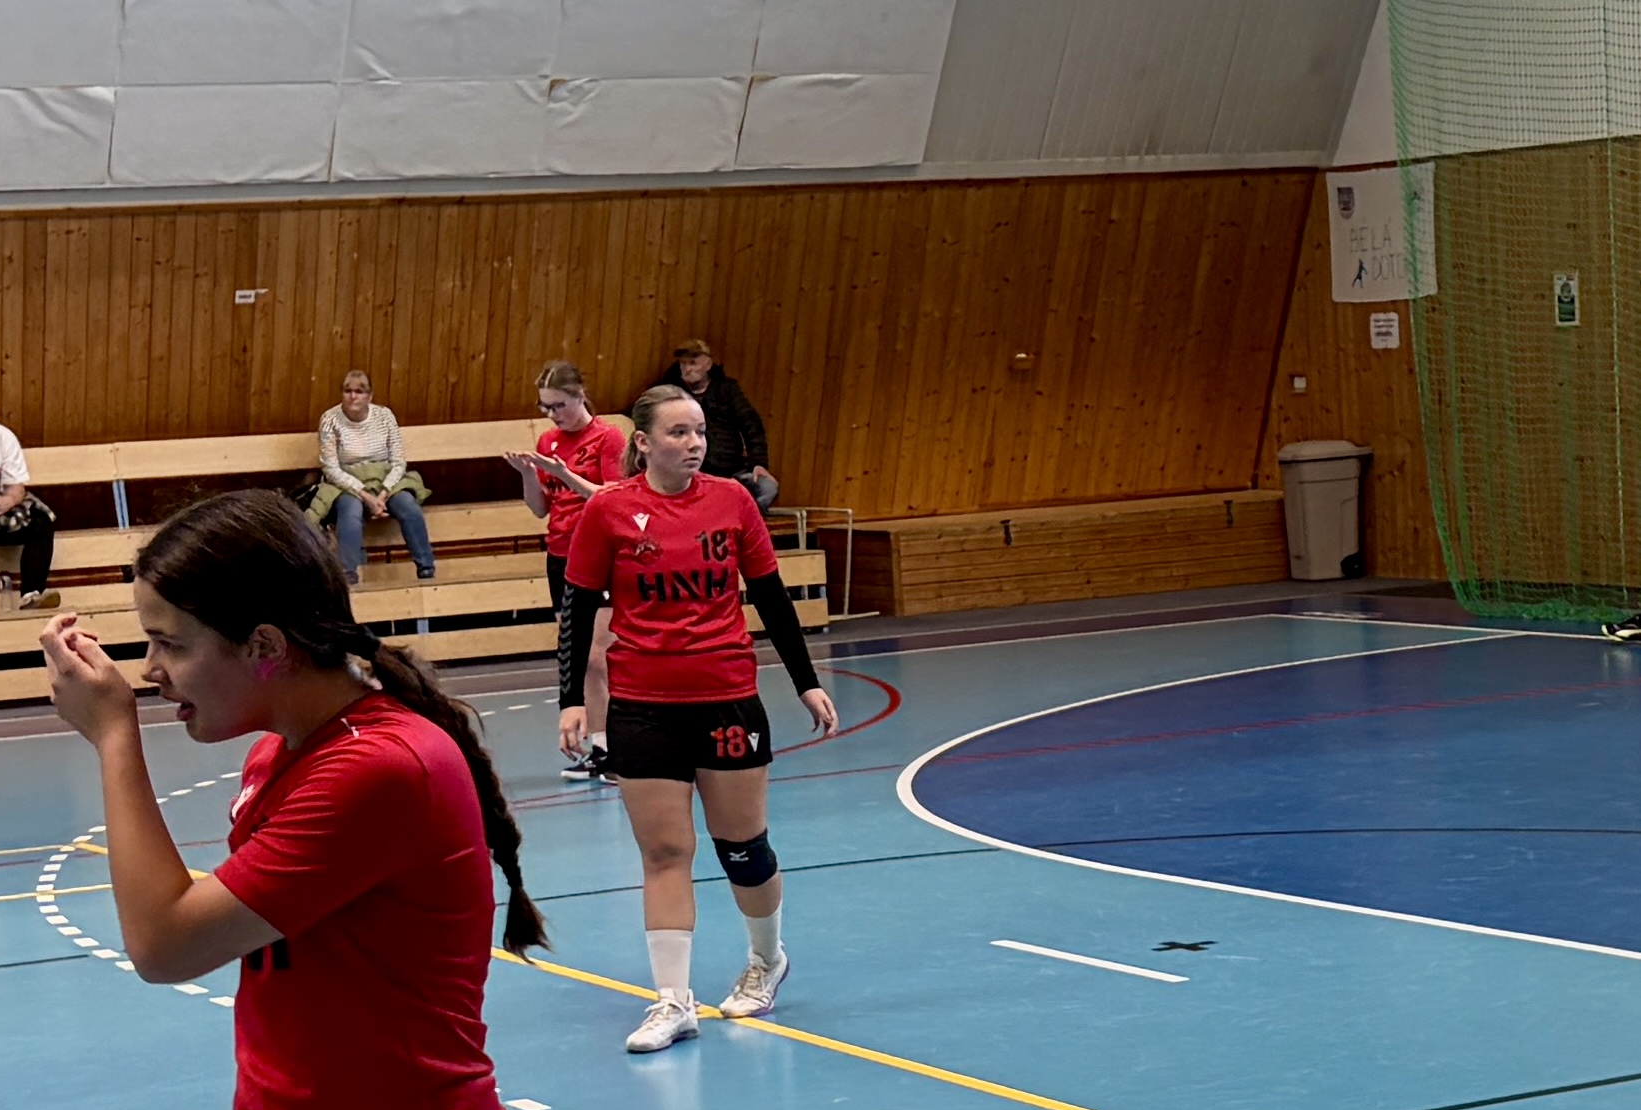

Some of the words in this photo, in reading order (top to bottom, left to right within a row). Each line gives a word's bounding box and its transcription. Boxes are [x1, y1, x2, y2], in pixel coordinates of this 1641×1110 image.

[695, 528, 729, 562] 18
[636, 566, 728, 602] HNH
[711, 726, 746, 758] 18
